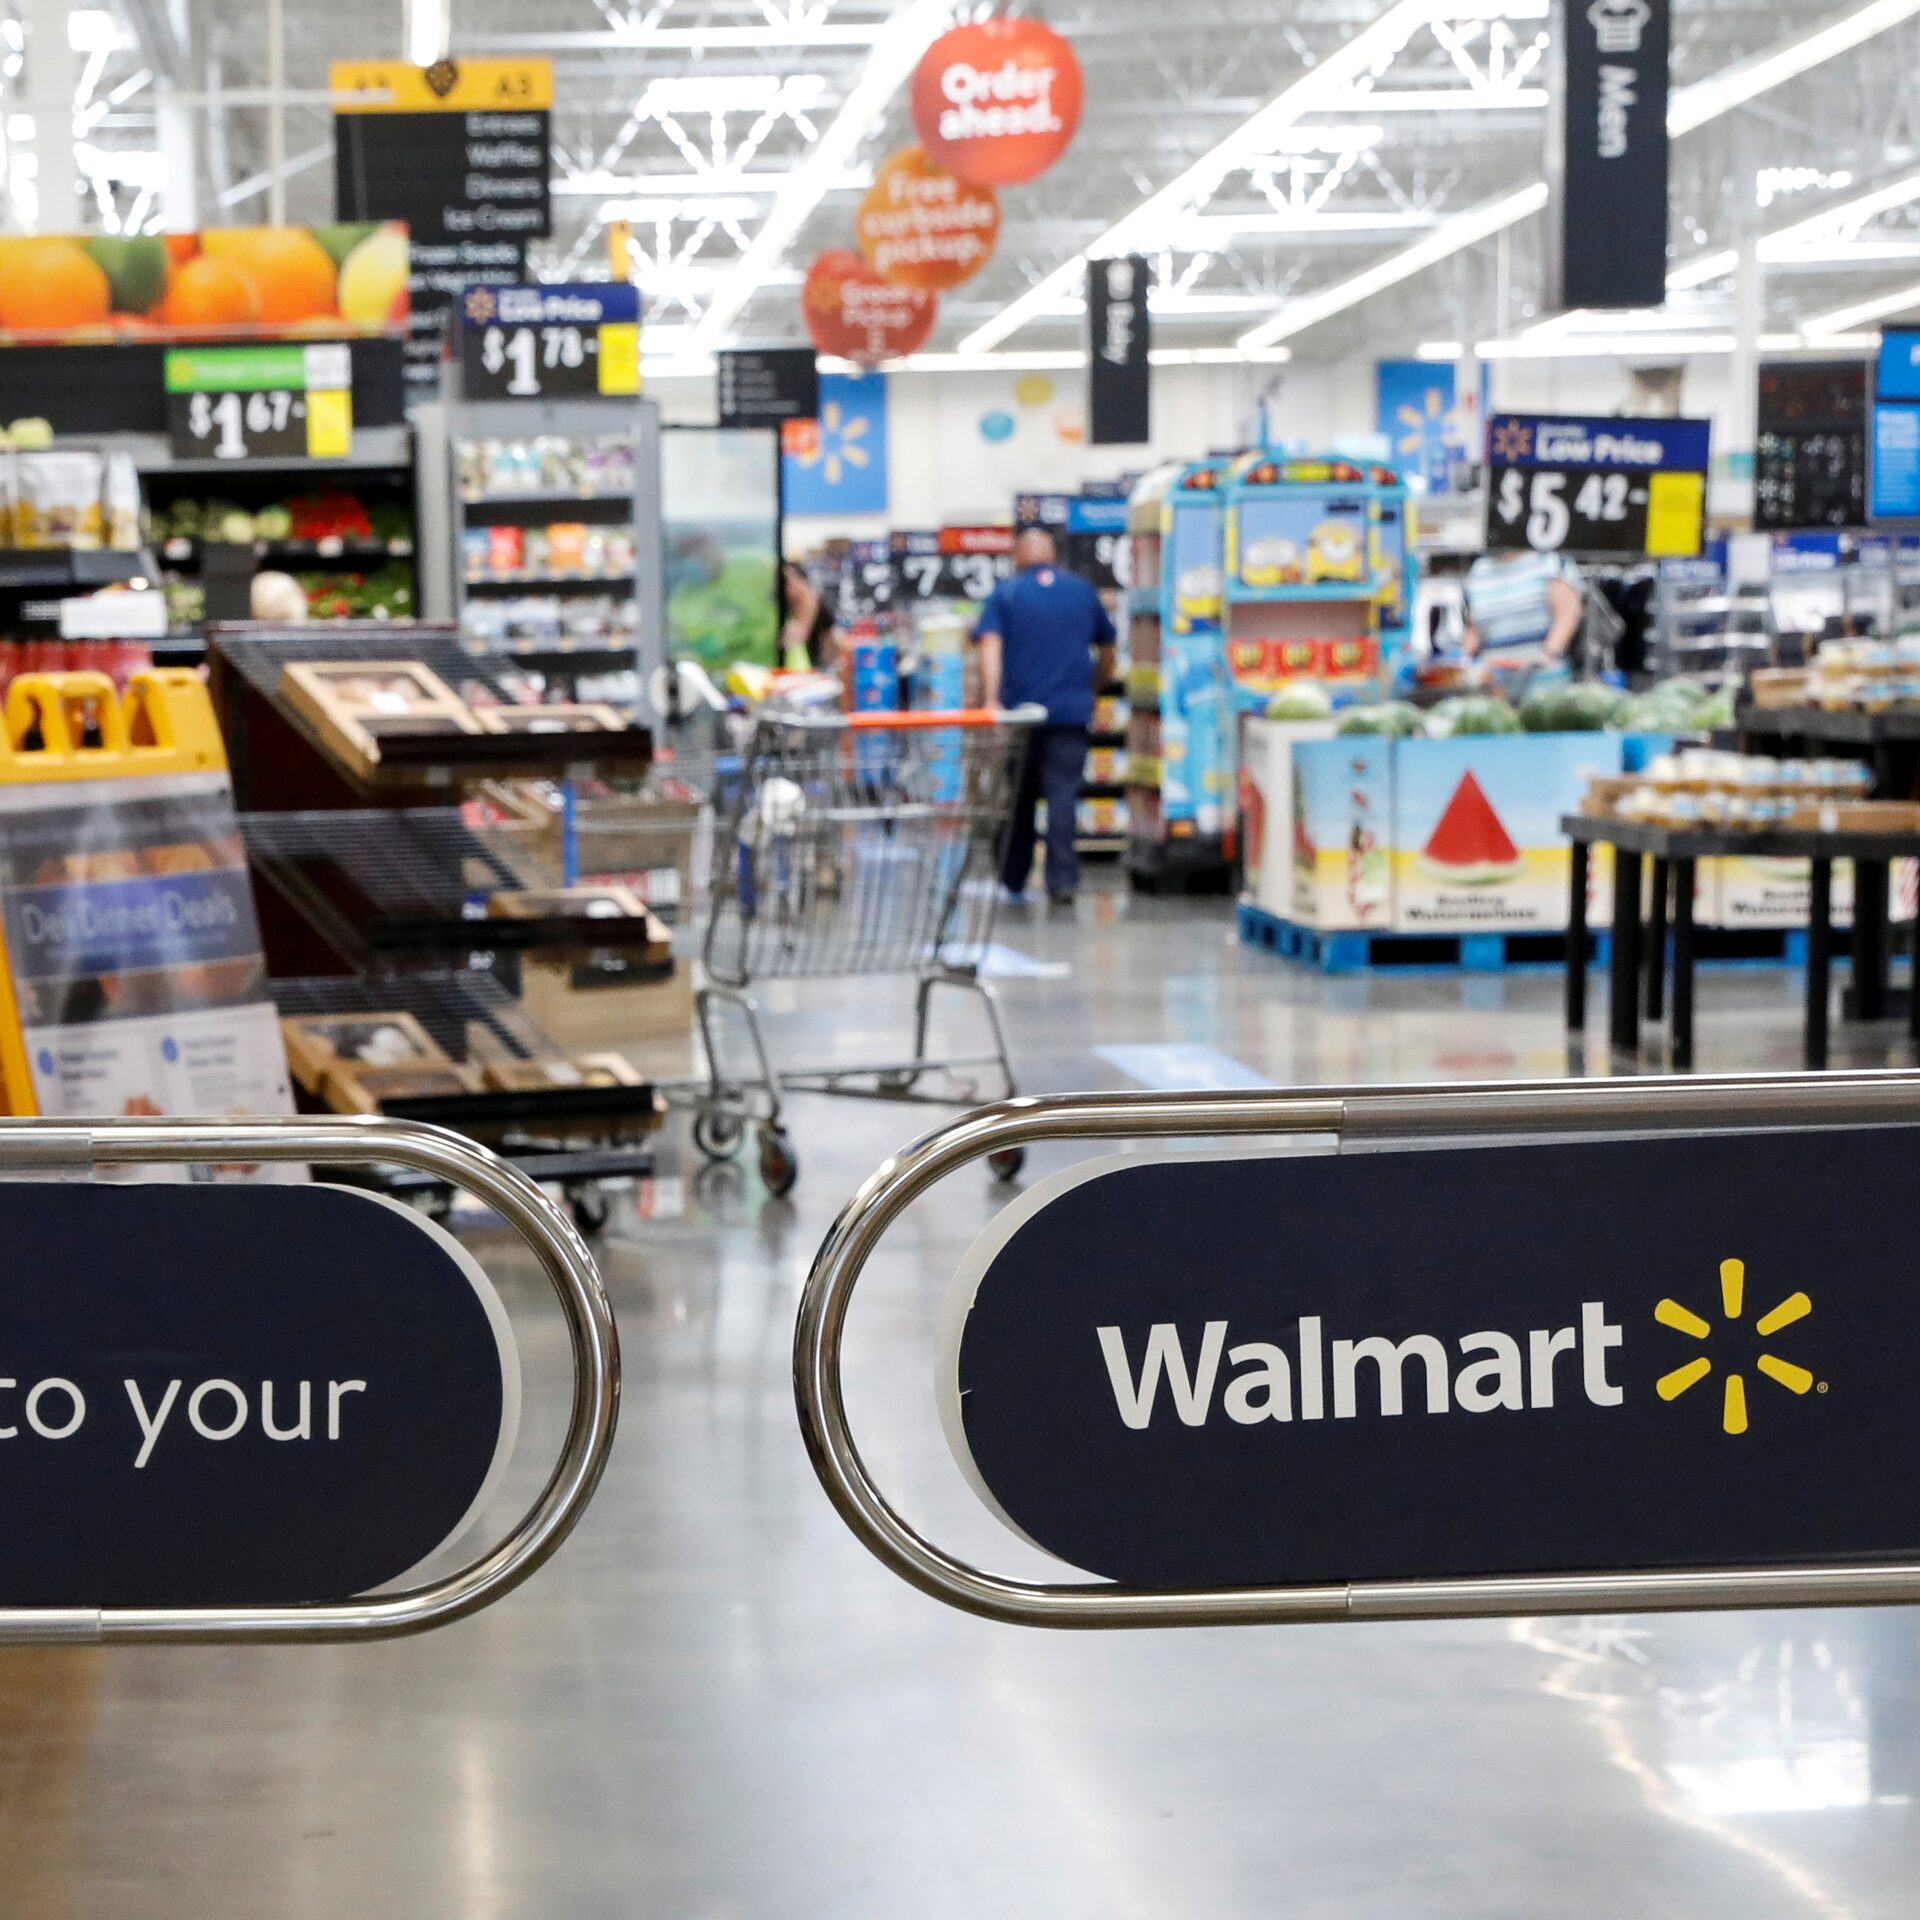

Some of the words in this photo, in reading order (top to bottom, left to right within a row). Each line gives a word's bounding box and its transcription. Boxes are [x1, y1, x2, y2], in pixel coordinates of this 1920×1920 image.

[941, 60, 1056, 105] Order
[938, 101, 1061, 140] ahead.
[1598, 65, 1638, 158] Men
[887, 174, 959, 203] Free
[863, 199, 994, 237] curbside
[1536, 424, 1593, 462] Low
[1594, 433, 1664, 465] Price
[1096, 1301, 1624, 1430] Walmart
[124, 1378, 367, 1468] your
